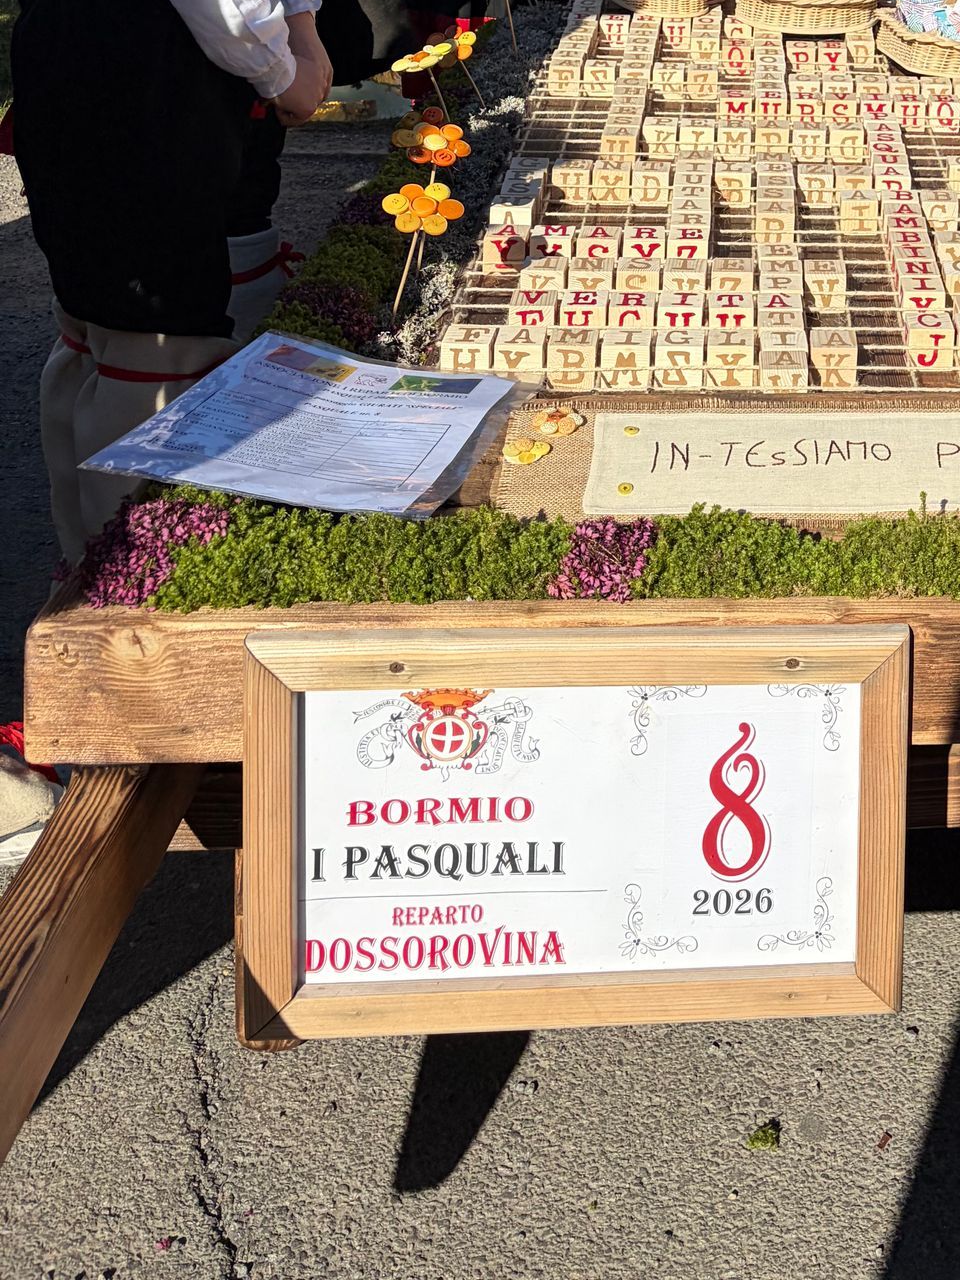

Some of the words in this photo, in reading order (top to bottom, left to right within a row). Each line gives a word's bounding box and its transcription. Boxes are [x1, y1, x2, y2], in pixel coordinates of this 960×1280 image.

[346, 795, 535, 827] BORMIO
[701, 721, 773, 883] 8
[311, 847, 325, 882] I
[342, 839, 567, 882] PASQUALI
[392, 903, 484, 927] REPARTO
[691, 887, 774, 917] 2026
[305, 923, 567, 974] DOSSOROVINA
